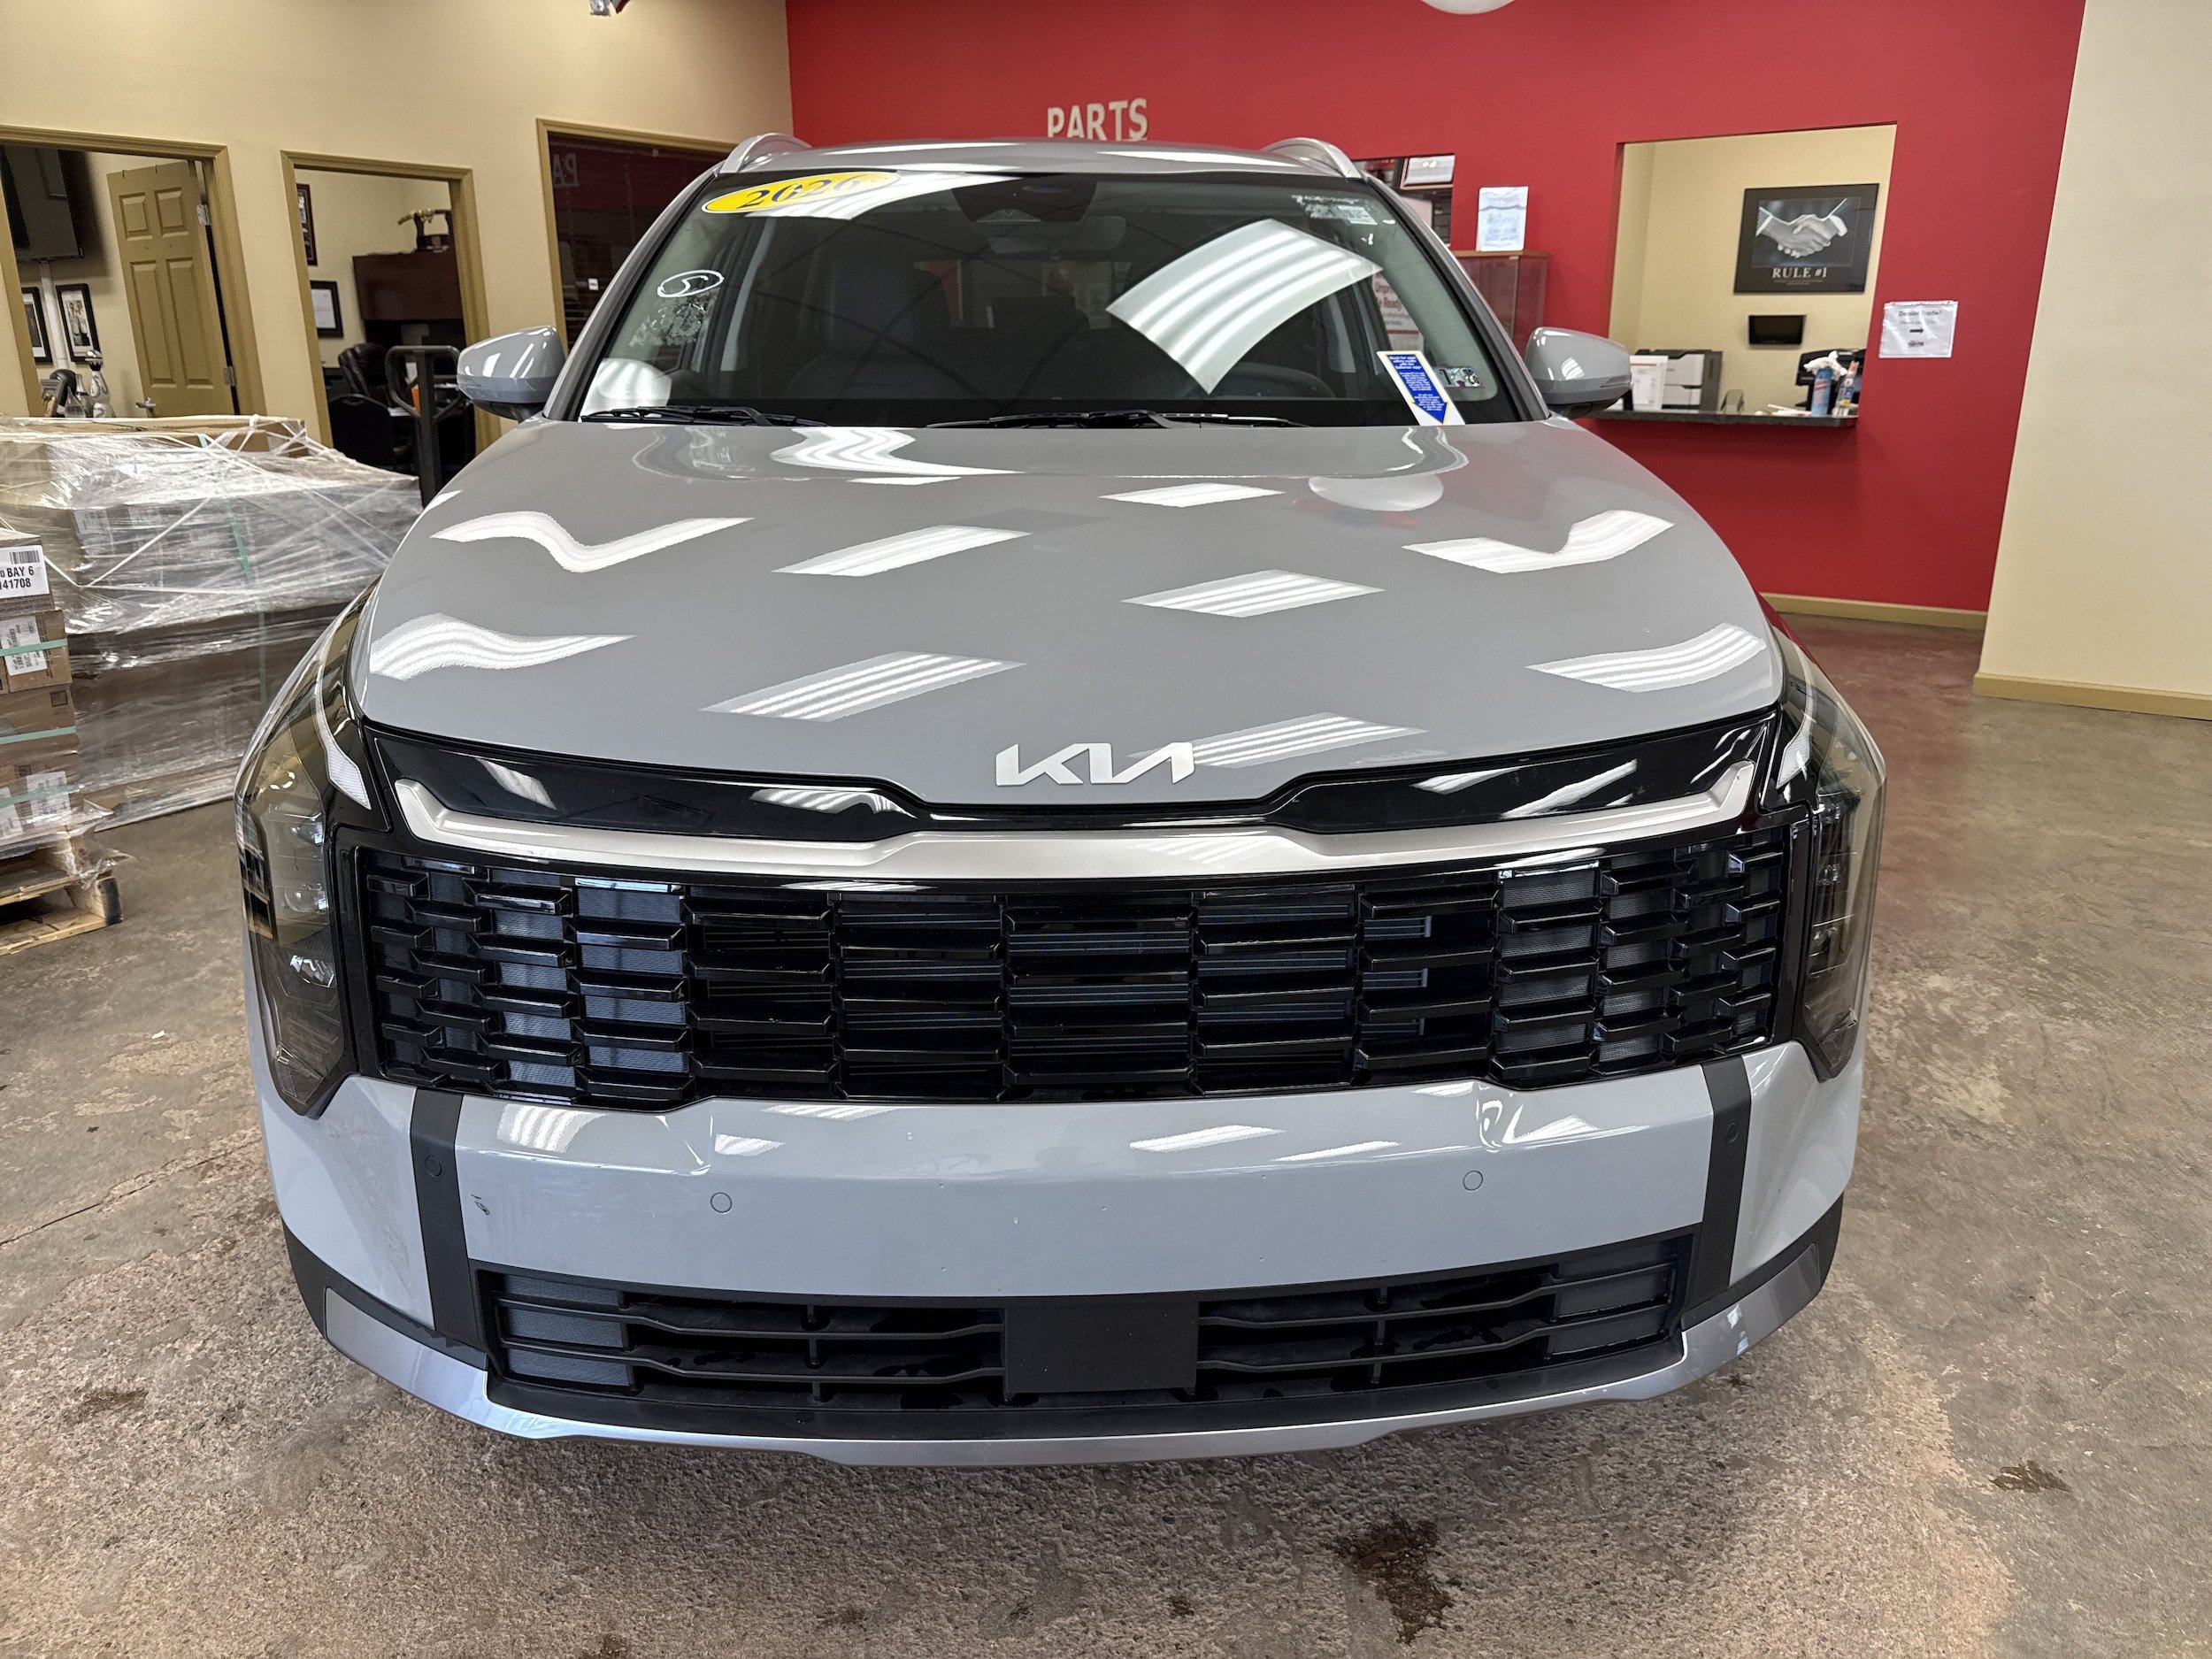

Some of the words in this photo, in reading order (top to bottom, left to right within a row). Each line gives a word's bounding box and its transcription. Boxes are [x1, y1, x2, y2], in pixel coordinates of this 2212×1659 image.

[1047, 97, 1148, 142] PARTS
[735, 173, 866, 211] 2026
[1771, 267, 1812, 279] RULE
[1815, 267, 1828, 278] #1
[7, 566, 25, 578] BAY
[28, 565, 35, 576] 6
